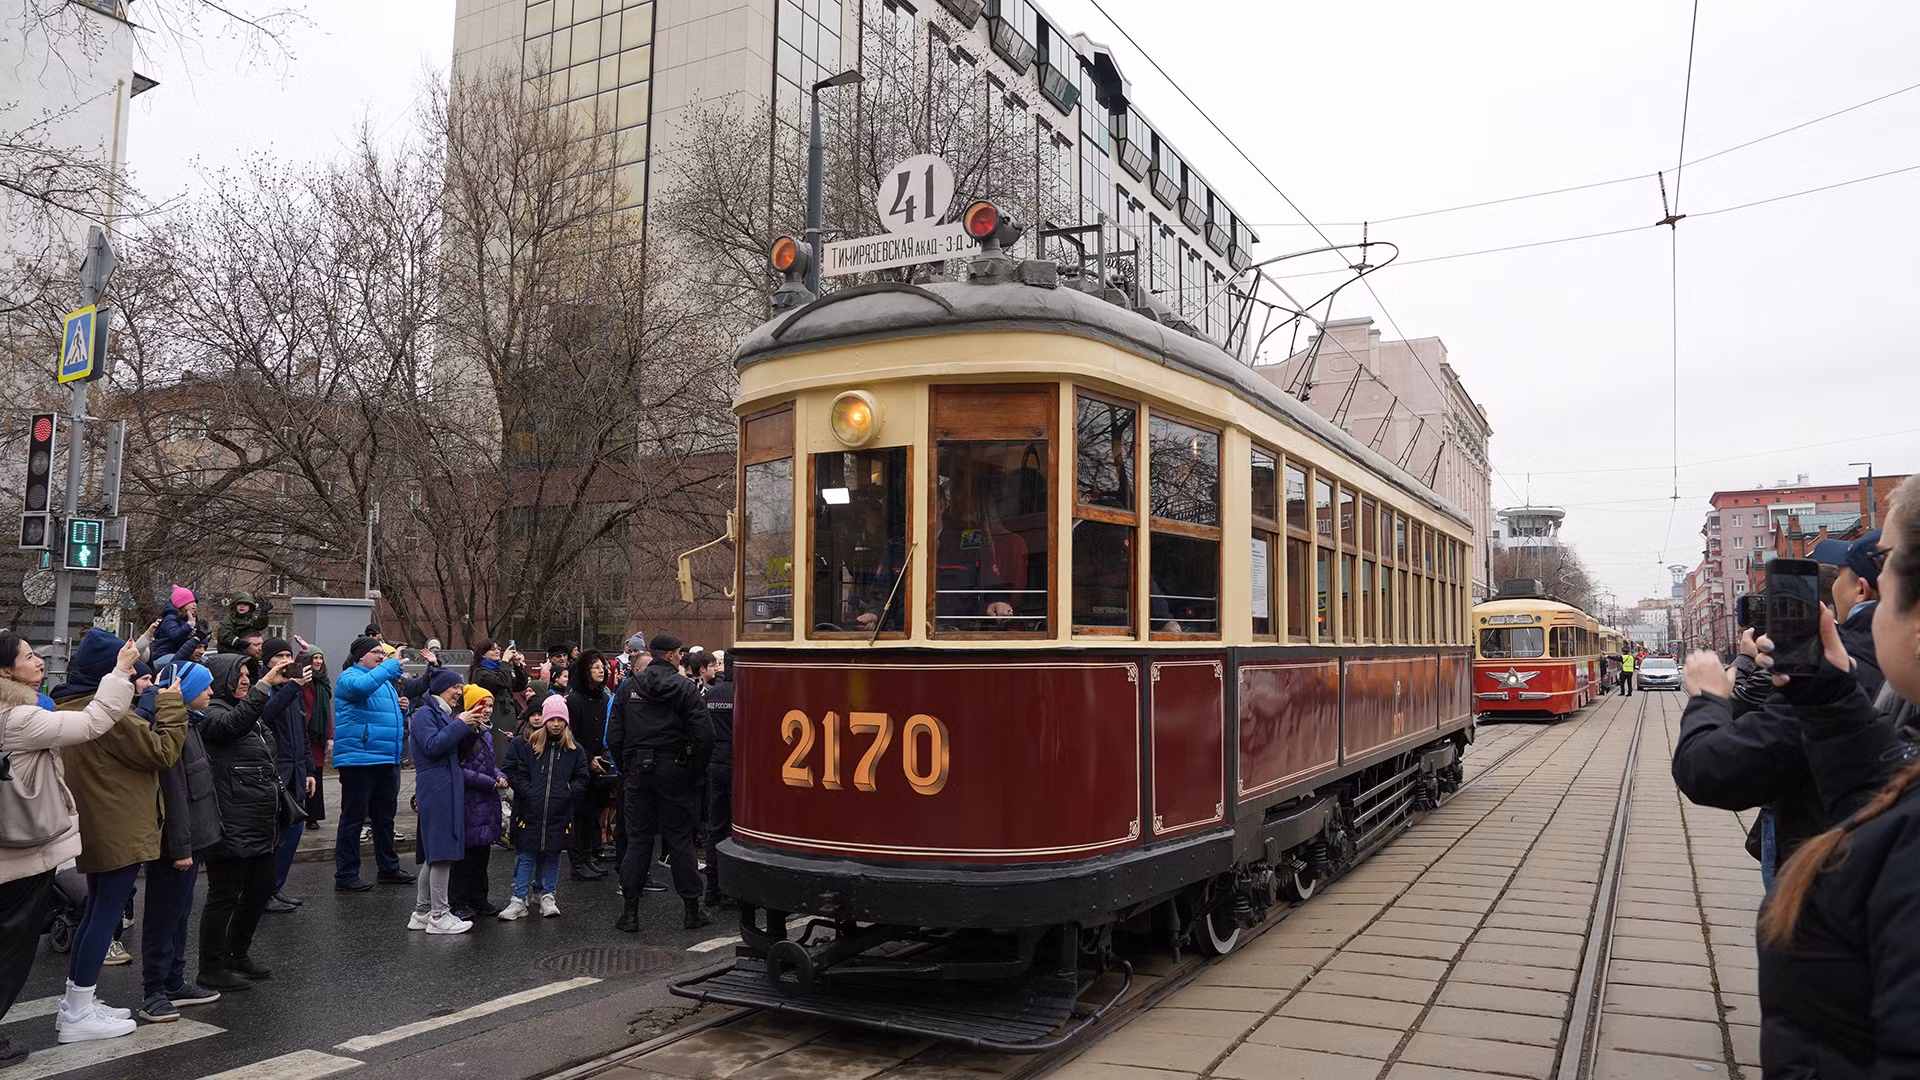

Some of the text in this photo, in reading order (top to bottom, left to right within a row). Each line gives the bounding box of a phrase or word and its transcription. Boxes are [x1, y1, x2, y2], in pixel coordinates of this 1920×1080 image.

[889, 164, 936, 224] 41
[832, 237, 914, 269] ТИМИРЯЗЕВСКАЯ
[73, 521, 99, 543] 07
[781, 709, 950, 796] 2170
